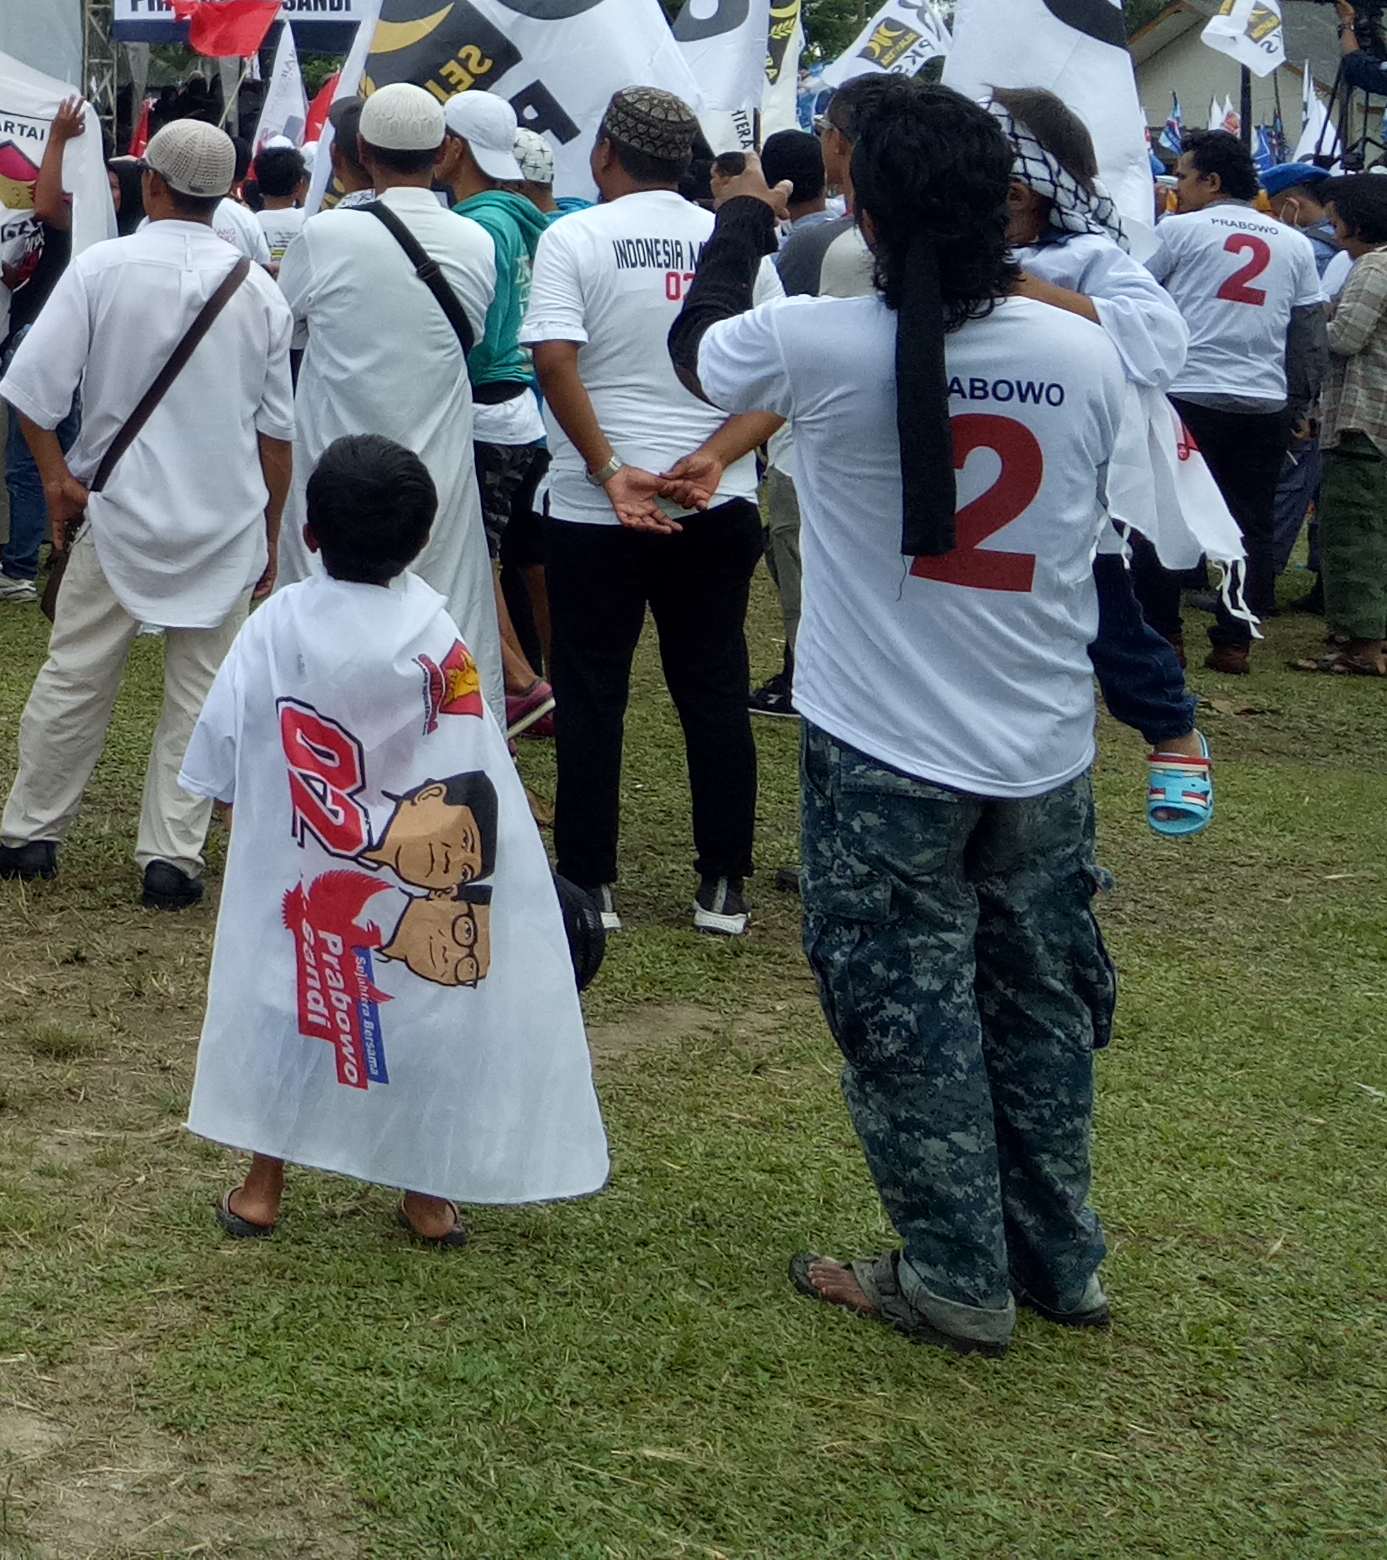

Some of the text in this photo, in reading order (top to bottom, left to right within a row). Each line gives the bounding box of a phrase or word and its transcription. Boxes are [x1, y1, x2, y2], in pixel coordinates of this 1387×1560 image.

[612, 238, 684, 270] INDONESIA
[1211, 217, 1279, 236] PRABOWO
[1215, 233, 1271, 307] 2
[948, 377, 1066, 409] ABOWO
[909, 413, 1044, 593] 2
[318, 929, 359, 1084] Prabowo
[362, 1019, 380, 1075] Bersama
